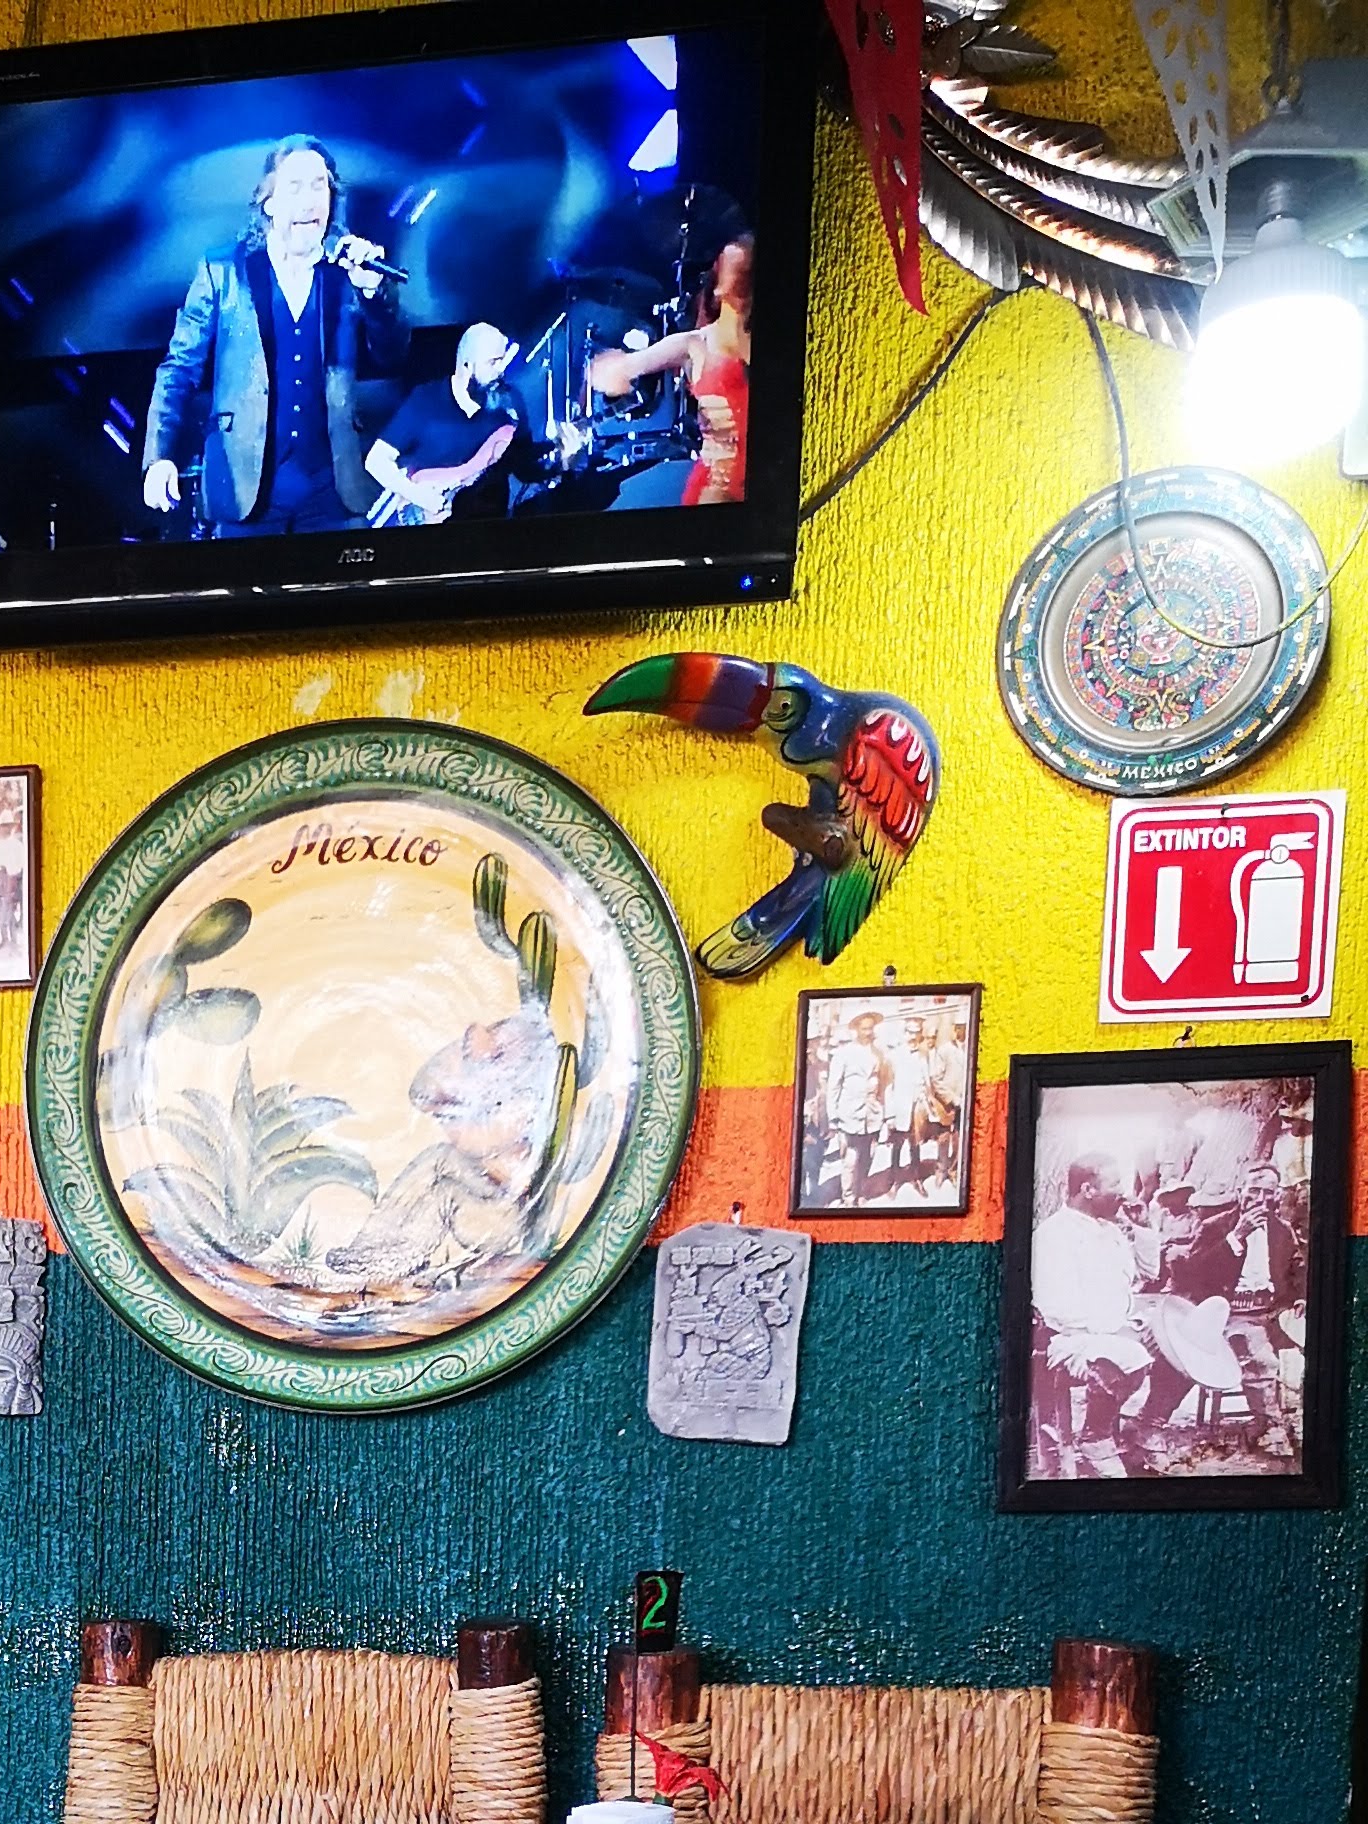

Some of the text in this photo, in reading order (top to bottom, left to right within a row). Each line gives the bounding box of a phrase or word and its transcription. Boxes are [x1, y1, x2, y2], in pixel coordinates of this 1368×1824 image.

[337, 548, 376, 564] AOC
[1121, 757, 1198, 780] MEXICO
[271, 820, 448, 875] México
[1134, 825, 1247, 853] EXTINTOR
[640, 1575, 669, 1636] 2
